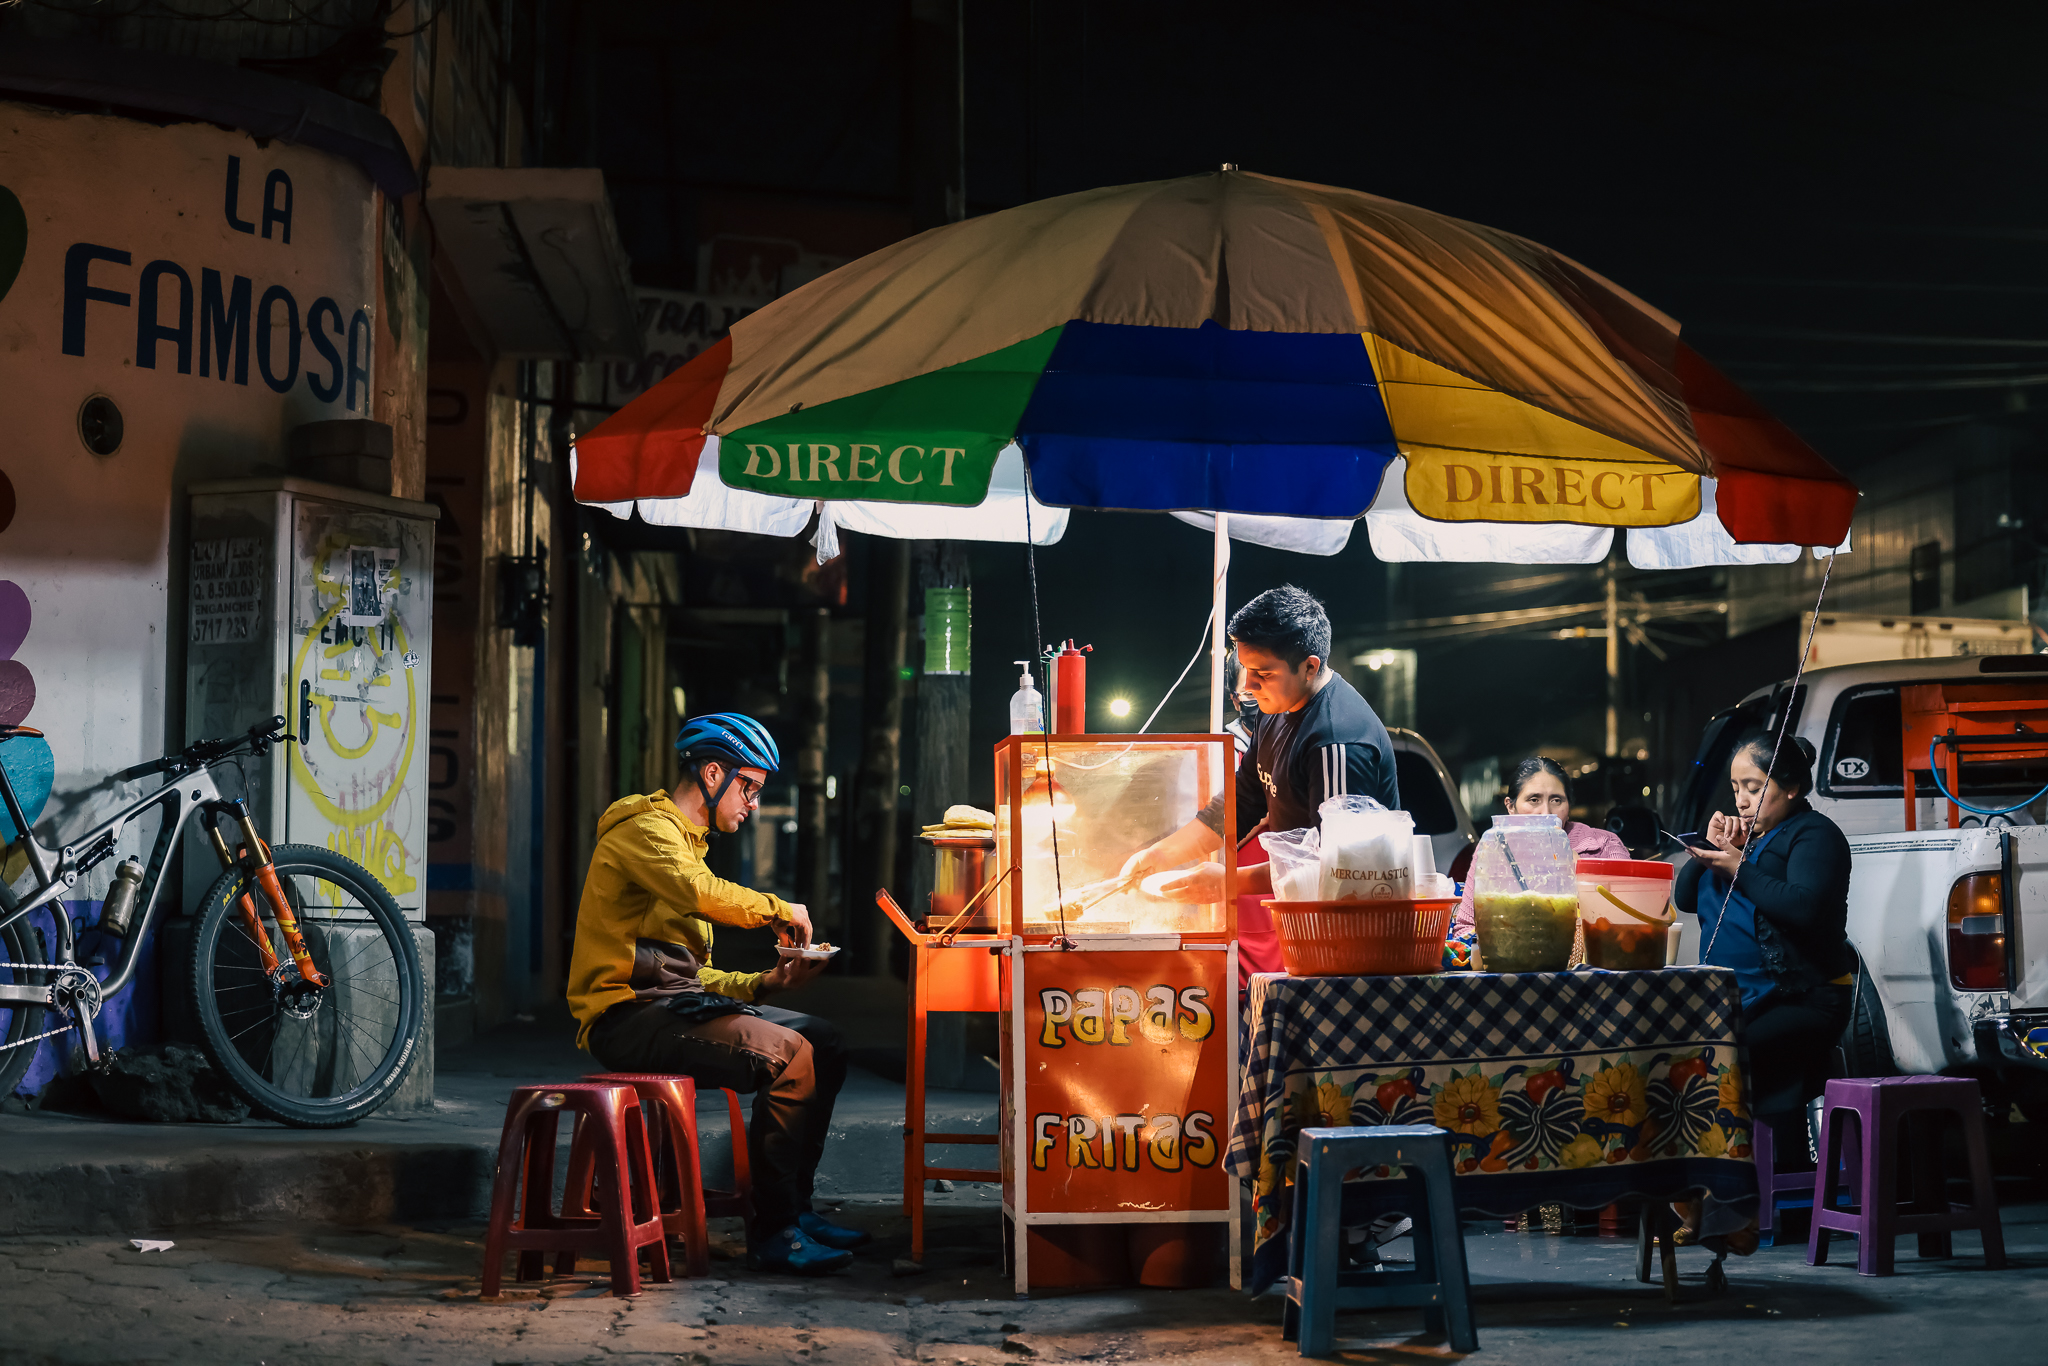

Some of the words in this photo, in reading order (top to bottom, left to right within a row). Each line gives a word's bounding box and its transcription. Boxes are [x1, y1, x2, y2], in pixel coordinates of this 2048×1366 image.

[224, 154, 294, 246] LA
[61, 242, 373, 416] FAMOSA
[743, 443, 966, 487] DIRECT
[1443, 464, 1666, 511] DIRECT
[195, 602, 254, 616] ENGANCHE
[1840, 762, 1865, 773] TX
[1330, 866, 1409, 881] MERCAPLASTIC
